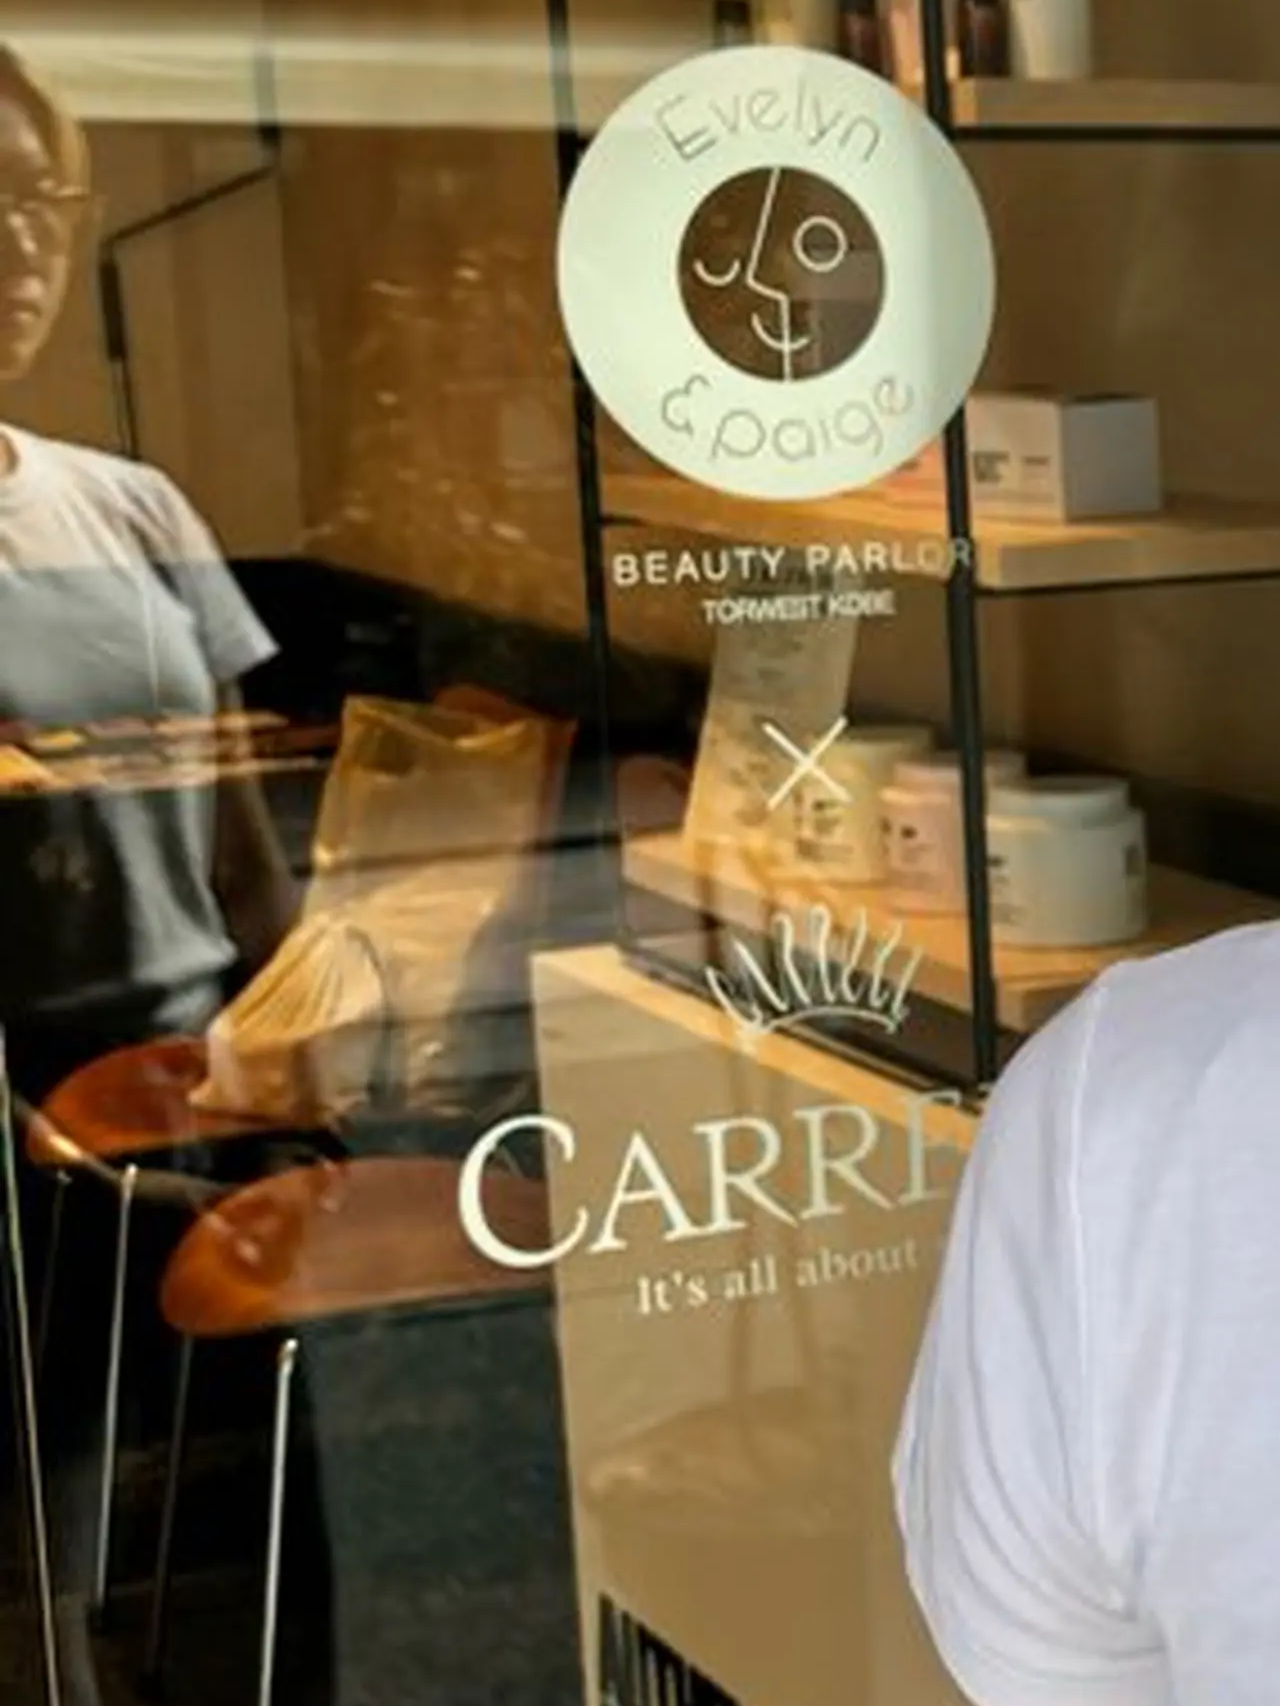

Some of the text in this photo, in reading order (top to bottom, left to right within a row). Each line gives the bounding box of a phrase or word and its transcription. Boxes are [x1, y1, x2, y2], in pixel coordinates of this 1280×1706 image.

[655, 81, 881, 163] Evelyn
[612, 537, 971, 587] BEAUTY PARLOR
[457, 1081, 997, 1269] CARRE
[637, 1238, 919, 1314] It's all about
